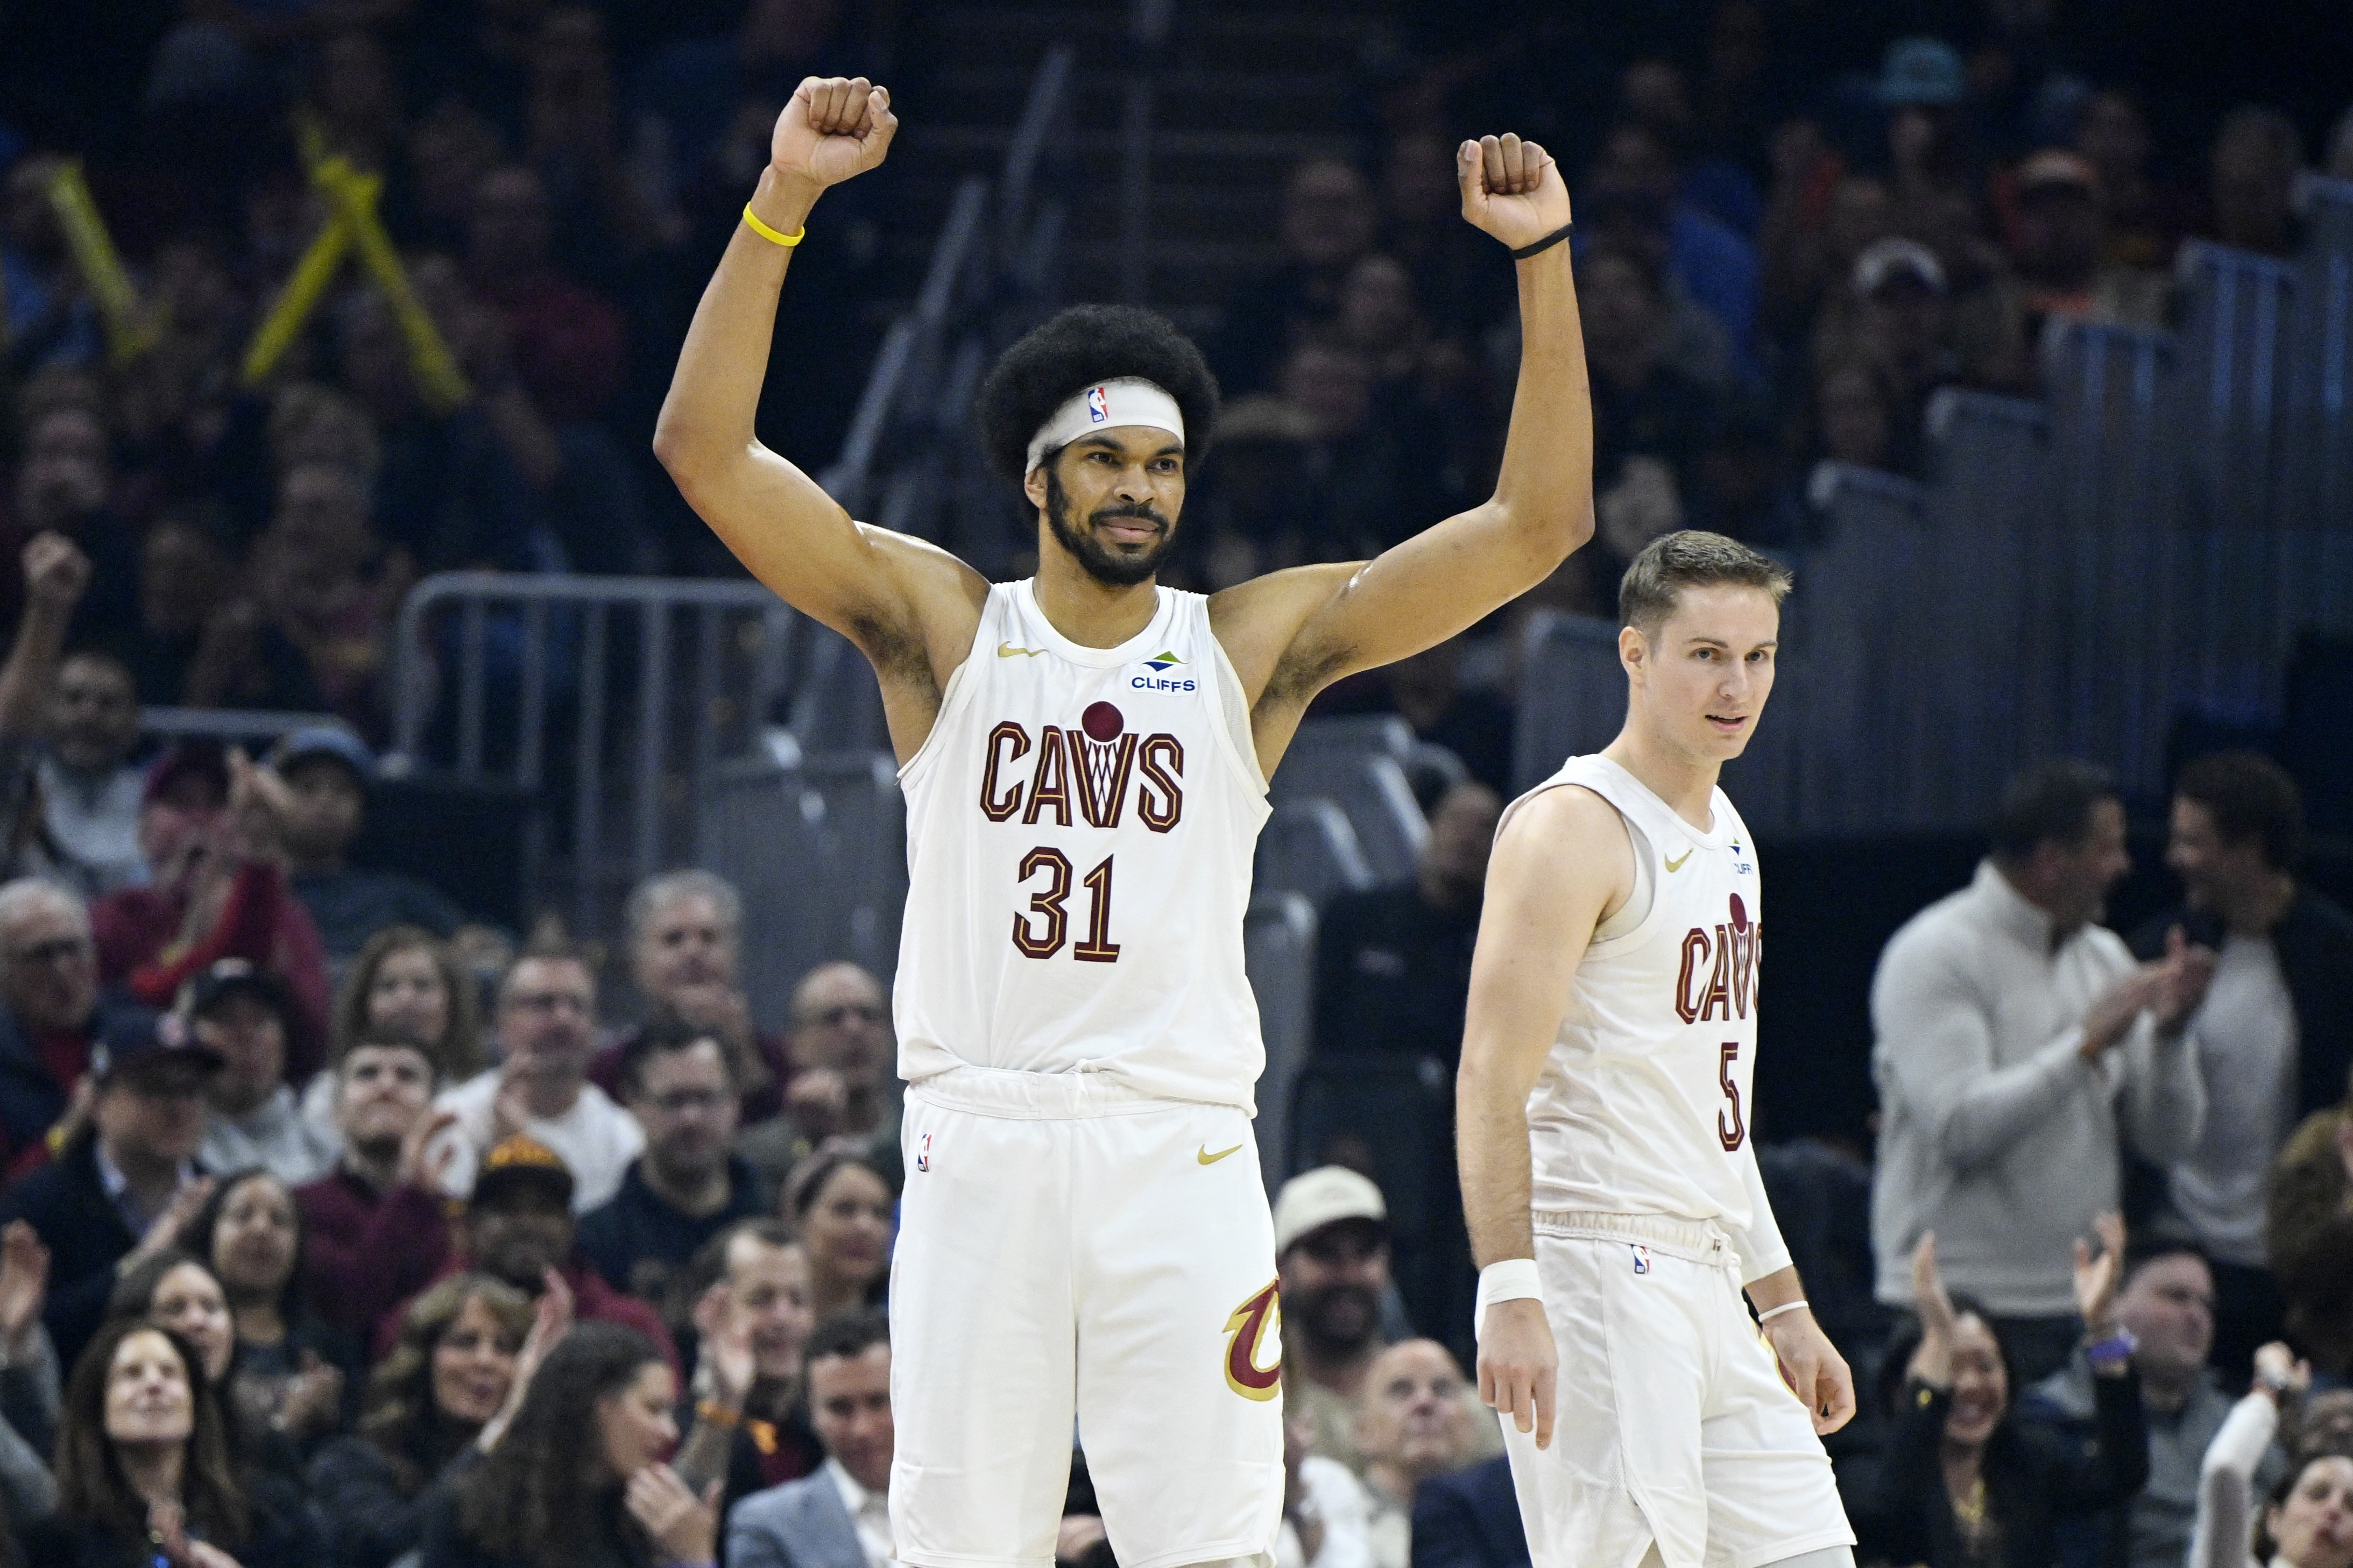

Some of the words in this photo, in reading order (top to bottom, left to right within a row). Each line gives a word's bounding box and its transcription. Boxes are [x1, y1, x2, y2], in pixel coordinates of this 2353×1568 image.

[1132, 677, 1195, 692] CLIFFS
[980, 721, 1184, 834] CAVS
[1012, 846, 1121, 963] 31
[1718, 1042, 1745, 1152] 5
